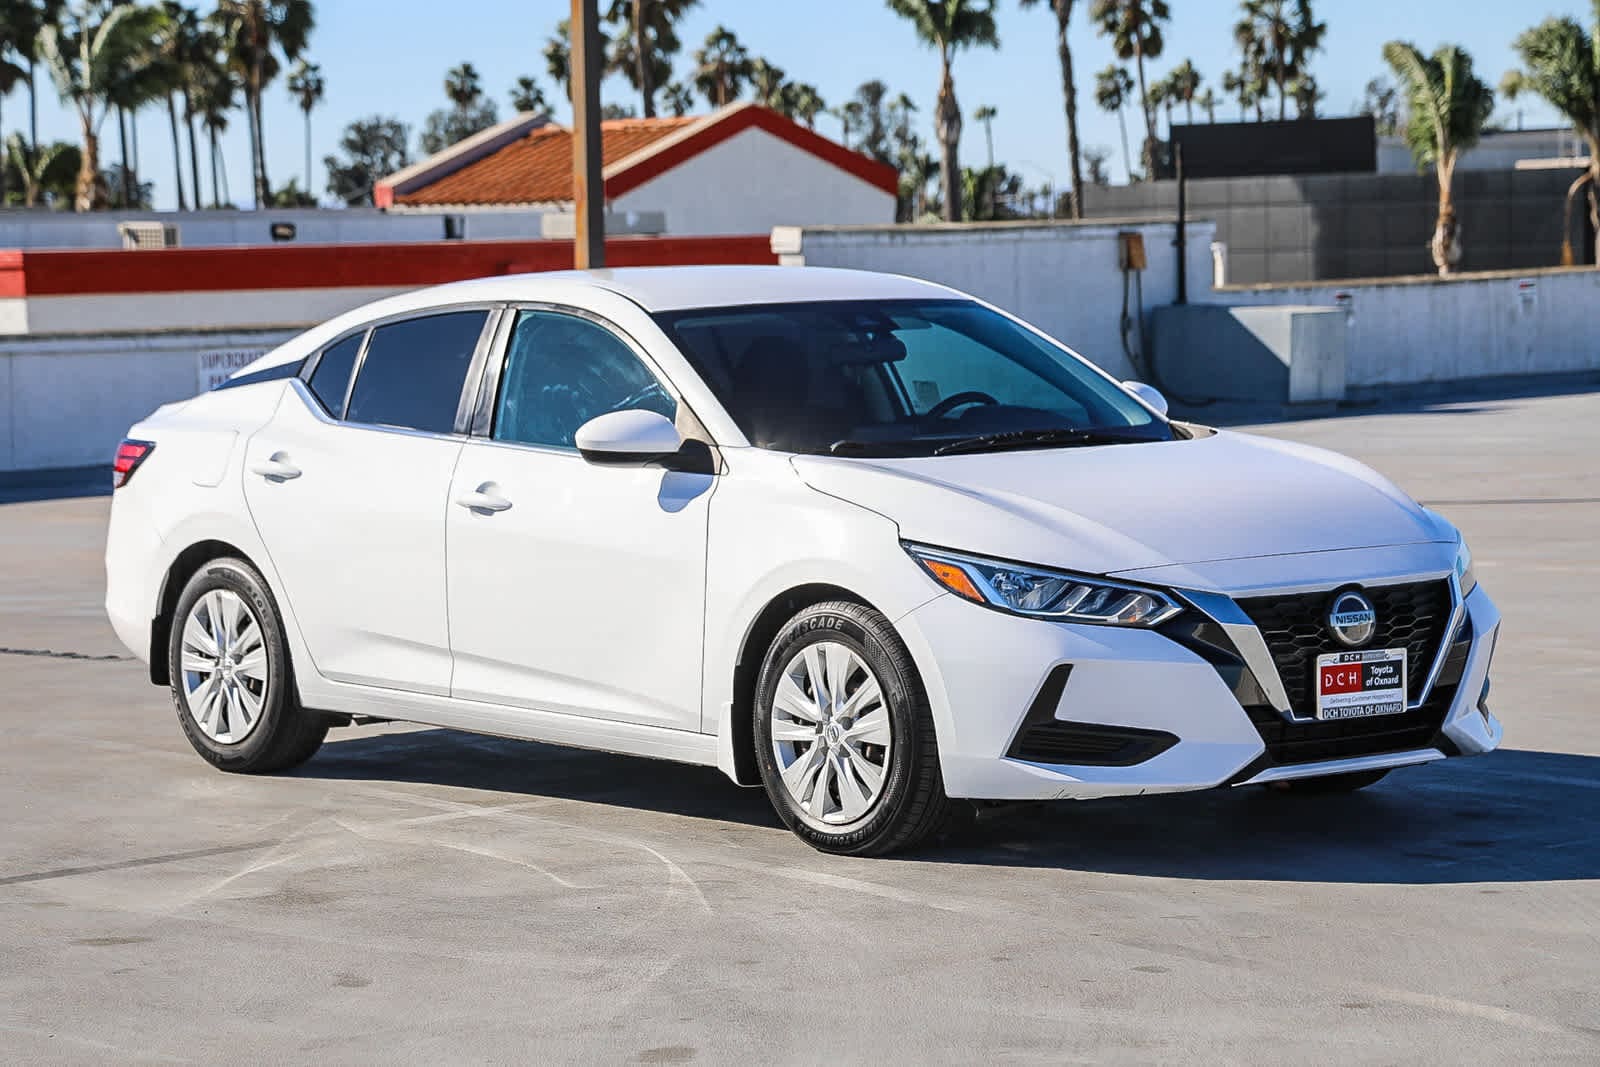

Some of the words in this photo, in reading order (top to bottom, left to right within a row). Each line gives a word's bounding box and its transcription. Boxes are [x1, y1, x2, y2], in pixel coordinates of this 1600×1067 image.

[1335, 612, 1371, 624] NISSAN
[1370, 665, 1394, 677] Toyota
[1365, 677, 1374, 687] of
[1374, 675, 1400, 686] Oxnard
[1323, 708, 1339, 719] DCH
[1340, 705, 1364, 717] TOYOTA
[1365, 704, 1375, 715] OF
[1375, 702, 1402, 714] OXNARD
